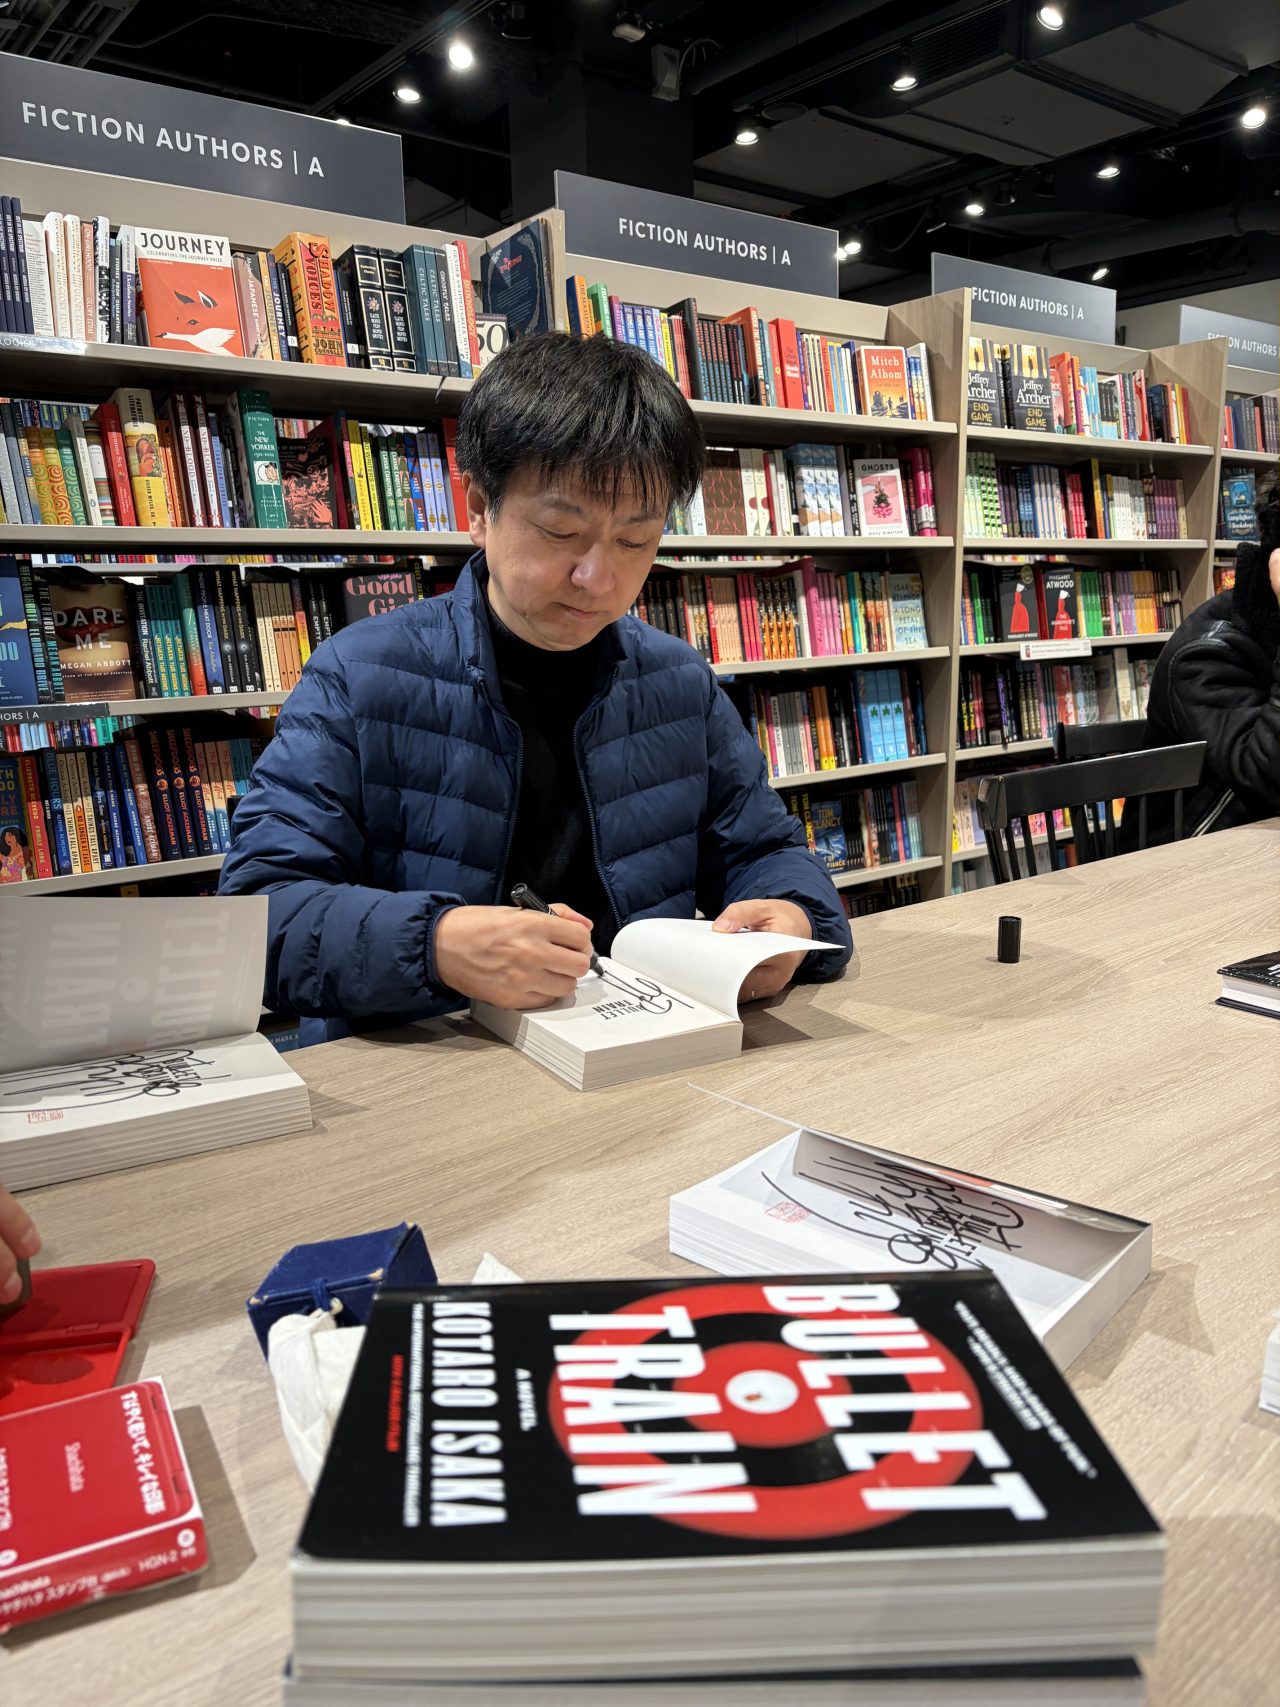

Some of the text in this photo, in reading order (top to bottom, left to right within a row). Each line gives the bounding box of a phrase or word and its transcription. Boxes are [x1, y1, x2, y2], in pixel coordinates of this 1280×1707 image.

[22, 101, 325, 177] FICTION AUTHORS A
[140, 232, 225, 257] JOURNEY
[618, 217, 791, 267] FICTION AUTHORS A
[306, 258, 322, 310] VOICES
[309, 242, 337, 315] SHADOW
[972, 287, 1084, 320] FICTION AUTHORS A
[313, 338, 342, 350] JOHN
[1241, 341, 1277, 356] AUTHORS
[871, 355, 899, 366] Mitch
[871, 369, 902, 379] Albom
[968, 372, 989, 385] Jeffrey
[1023, 380, 1043, 393] Jeffrey
[1017, 392, 1051, 405] Archer
[973, 403, 989, 412] END
[1028, 408, 1043, 417] END
[971, 412, 992, 422] GAME
[1026, 417, 1047, 427] GAME
[250, 443, 275, 451] YORKER
[861, 463, 895, 472] GHOSTS
[1046, 580, 1074, 589] ATWOOD
[901, 606, 921, 614] LONG
[53, 608, 125, 627] DARE
[901, 616, 918, 624] PETAL
[75, 633, 111, 650] ME
[60, 659, 131, 670] MEGAN ABBOTT
[818, 808, 834, 819] TOM
[763, 1284, 1048, 1521] BULLET
[429, 1301, 508, 1528] KOTARO ISAKA
[549, 1305, 758, 1515] TRAIN
